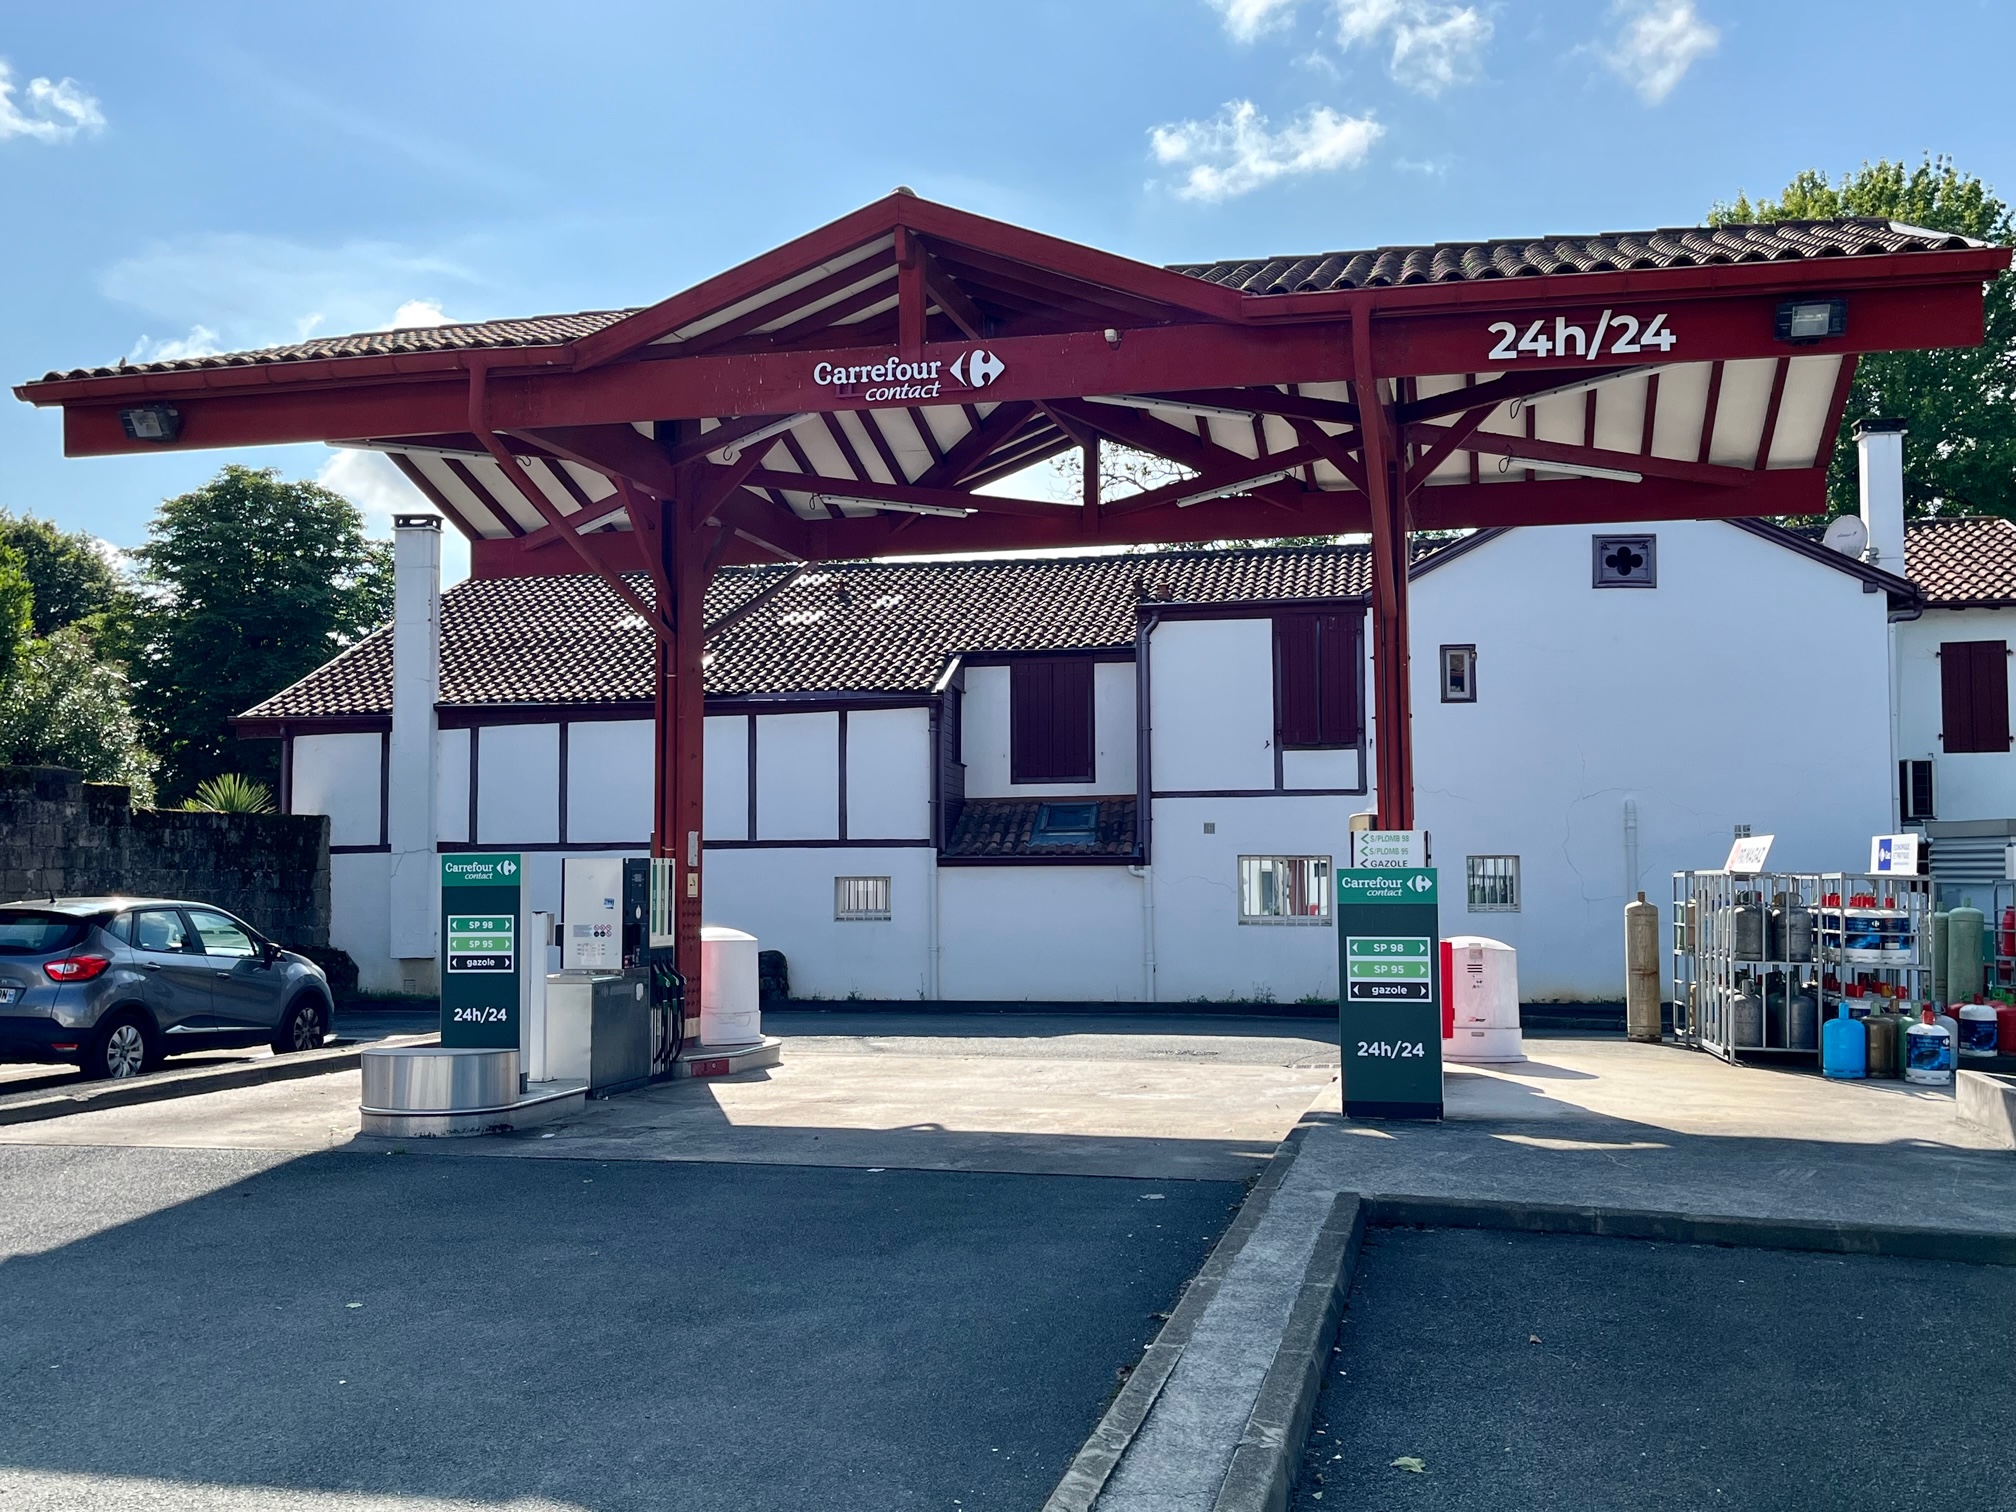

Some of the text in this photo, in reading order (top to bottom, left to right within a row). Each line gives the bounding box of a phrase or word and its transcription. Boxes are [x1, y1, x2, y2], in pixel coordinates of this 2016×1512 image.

[1487, 309, 1677, 361] 24h/24
[813, 356, 942, 385] Carrefour
[865, 380, 942, 401] contact
[1369, 834, 1410, 843] S/PLOMB 98
[1369, 847, 1409, 856] S/PLOMB 95
[445, 861, 494, 873] Carrefour
[1370, 859, 1408, 868] GAZOLE
[464, 872, 494, 880] contact
[1341, 876, 1403, 889] Carrefour
[1366, 887, 1403, 897] contact
[468, 920, 494, 929] SP 98
[468, 940, 494, 948] SP 95
[1373, 943, 1404, 953] SP 98
[466, 957, 496, 967] gazole
[1373, 964, 1405, 974] SP 95
[1371, 985, 1408, 996] gazole
[453, 1006, 508, 1024] 24h/24
[1357, 1040, 1425, 1060] 24h/24
